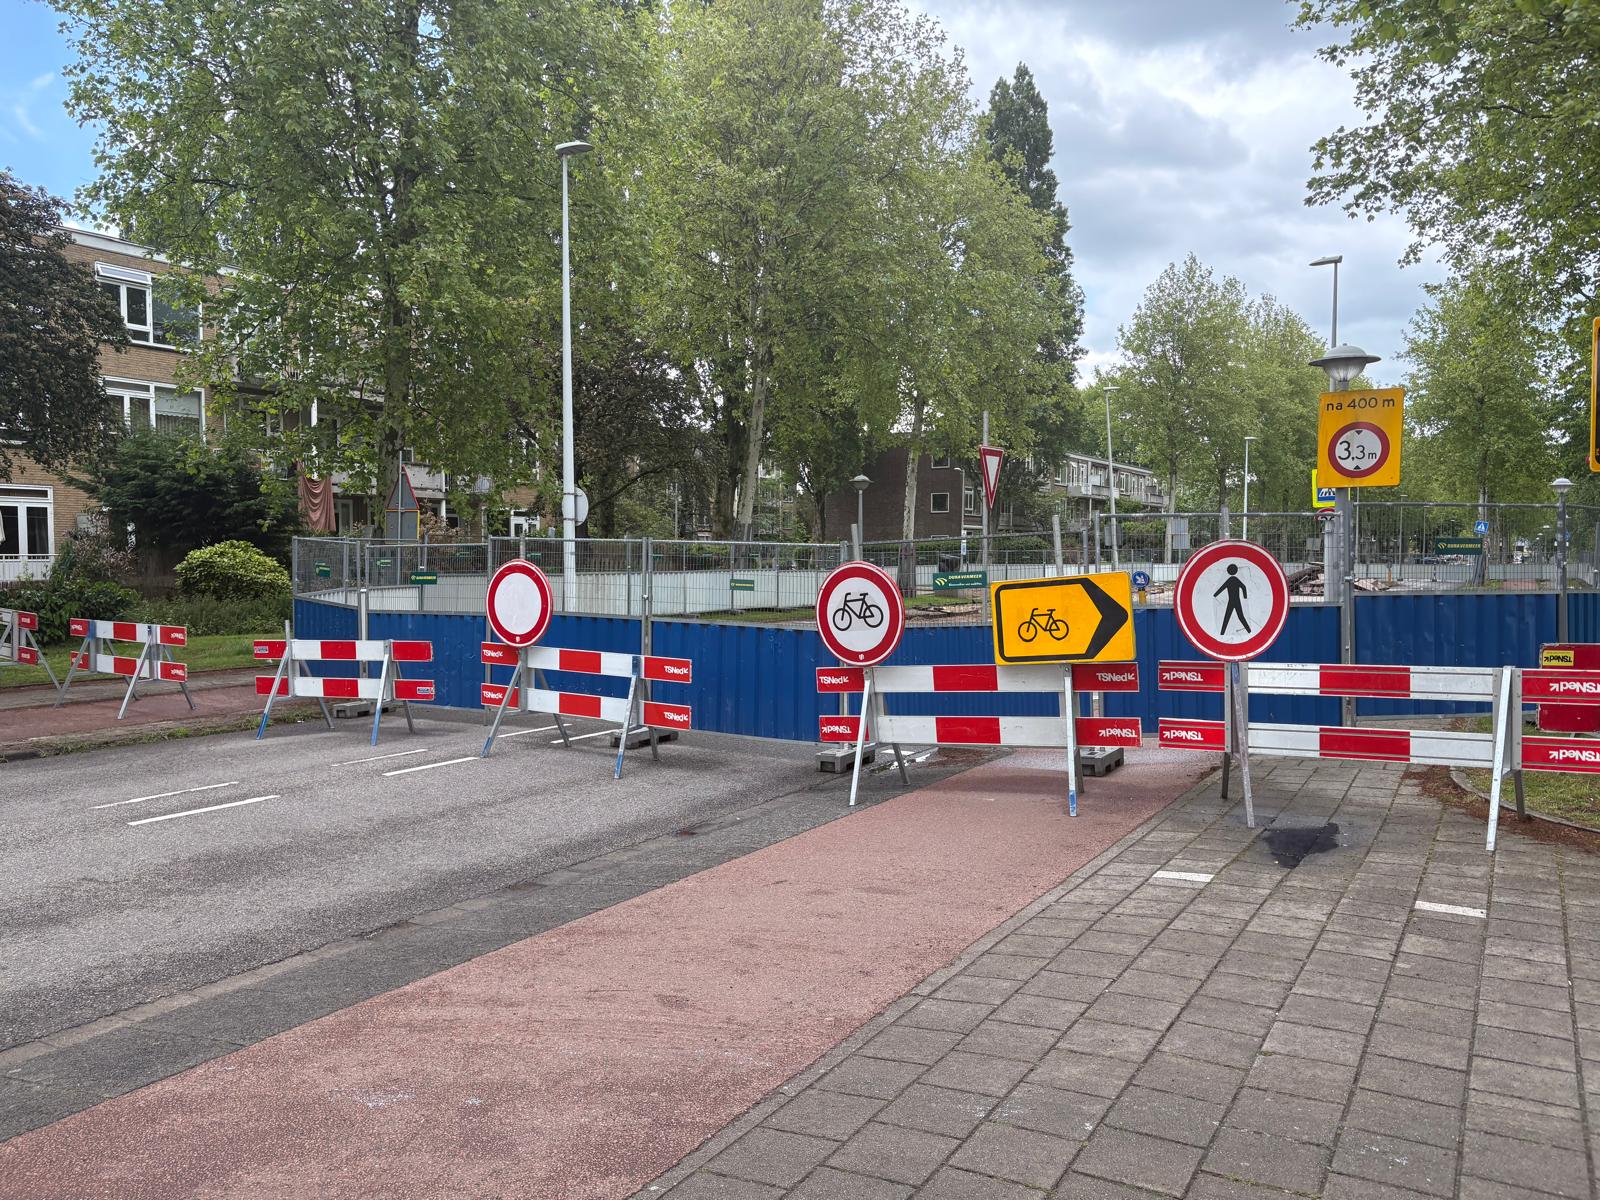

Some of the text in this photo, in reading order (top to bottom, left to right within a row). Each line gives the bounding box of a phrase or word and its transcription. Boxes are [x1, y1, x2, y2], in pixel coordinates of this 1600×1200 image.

[1326, 397, 1395, 411] na 400 m
[1338, 440, 1377, 461] 3,3 m
[819, 676, 843, 684] TSNed
[1096, 672, 1128, 682] TSNed
[1170, 671, 1204, 682] TSNed
[1170, 729, 1204, 741] TSNed
